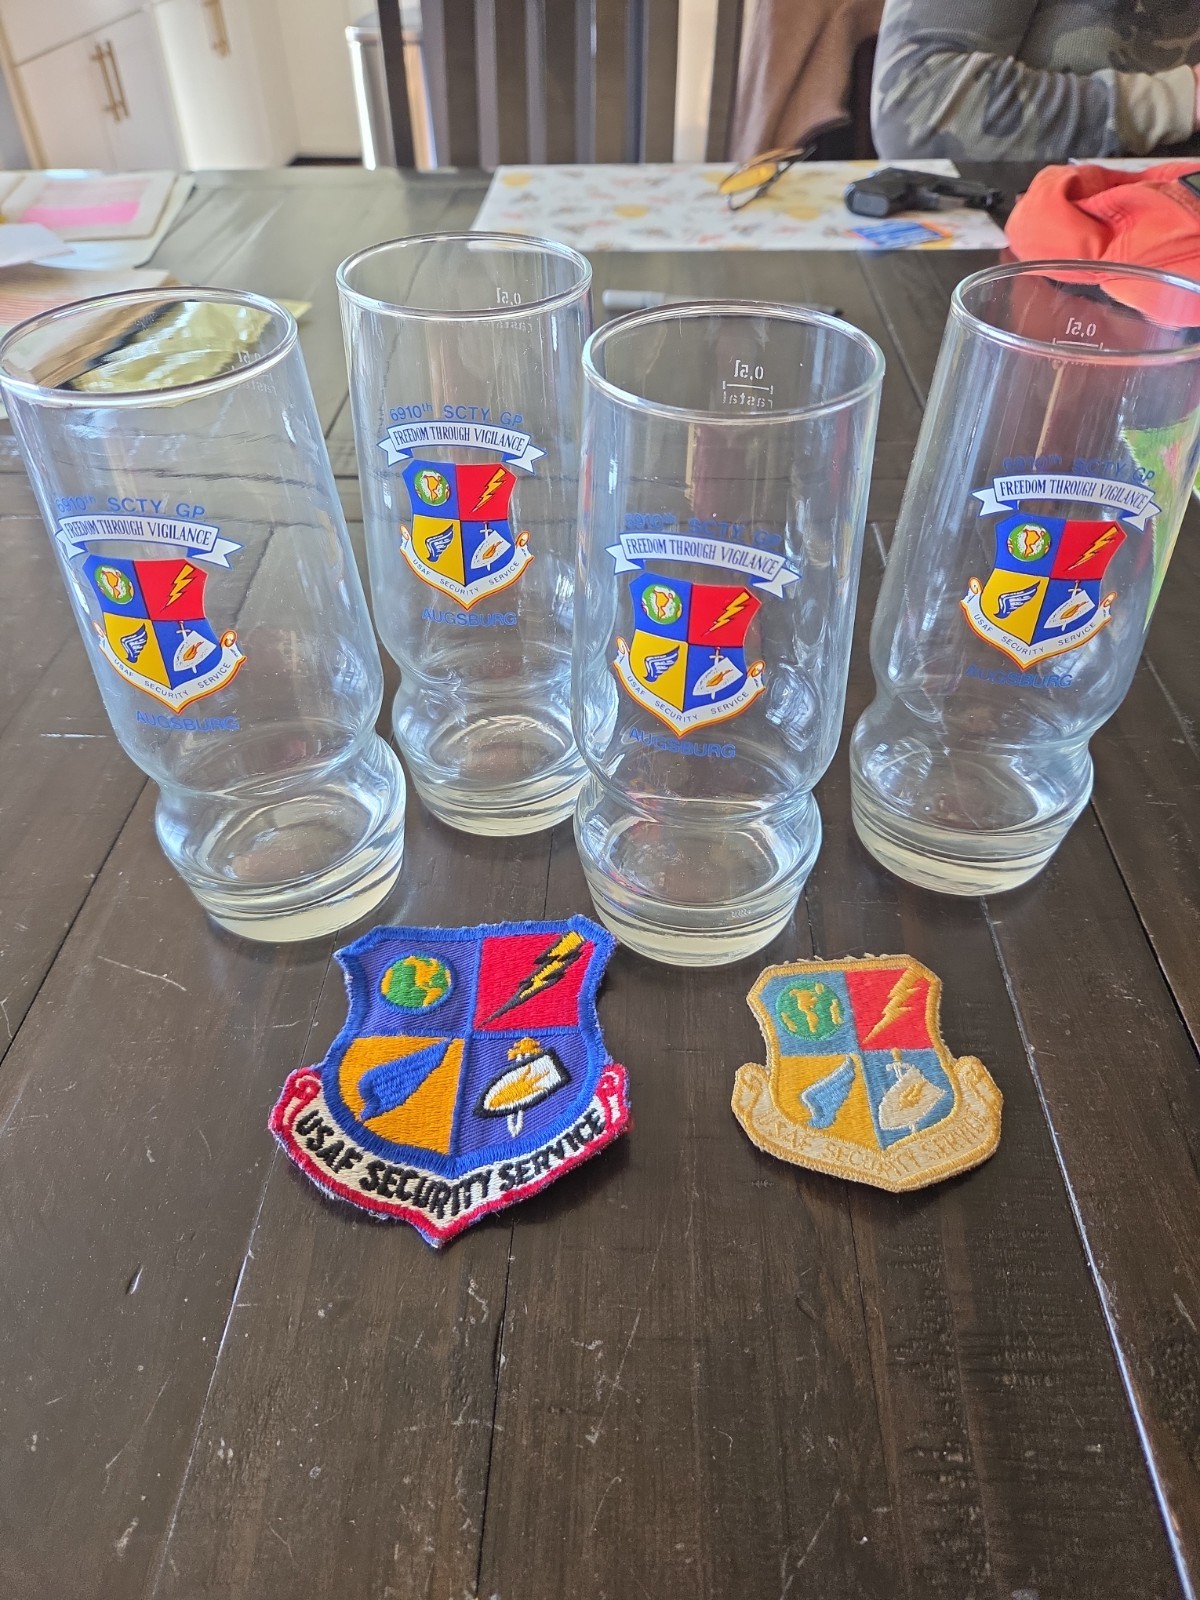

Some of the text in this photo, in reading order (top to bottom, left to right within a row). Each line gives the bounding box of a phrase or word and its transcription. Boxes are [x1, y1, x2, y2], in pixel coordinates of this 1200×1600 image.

[389, 402, 524, 428] 6910th SCTY GP
[393, 426, 525, 452] FREEDOM THROUGH VIGILANCE
[1132, 466, 1156, 483] GP
[107, 497, 163, 514] SCTY
[176, 502, 206, 519] GP
[999, 479, 1149, 510] FREEDOM THROUGH VIGILANCE
[63, 519, 213, 546] FREEDOM THROUGH VIGILANCE
[625, 537, 779, 576] FREEDOM THROUGH VIGILANCE
[412, 559, 521, 596] USAF SECURITY SERVICE
[421, 607, 518, 628] AUGSBURG
[972, 613, 1098, 656] USAF SECURITY SERVICE
[113, 658, 232, 700] USAF SECURITY SERVICE
[965, 664, 1073, 689] AUGSBURG
[625, 675, 750, 724] USAF SECURITY SERVICE
[135, 709, 241, 732] AUGSBURG
[629, 727, 737, 759] AUGSBURG
[294, 1107, 606, 1220] USAF SECURITY SERVICE
